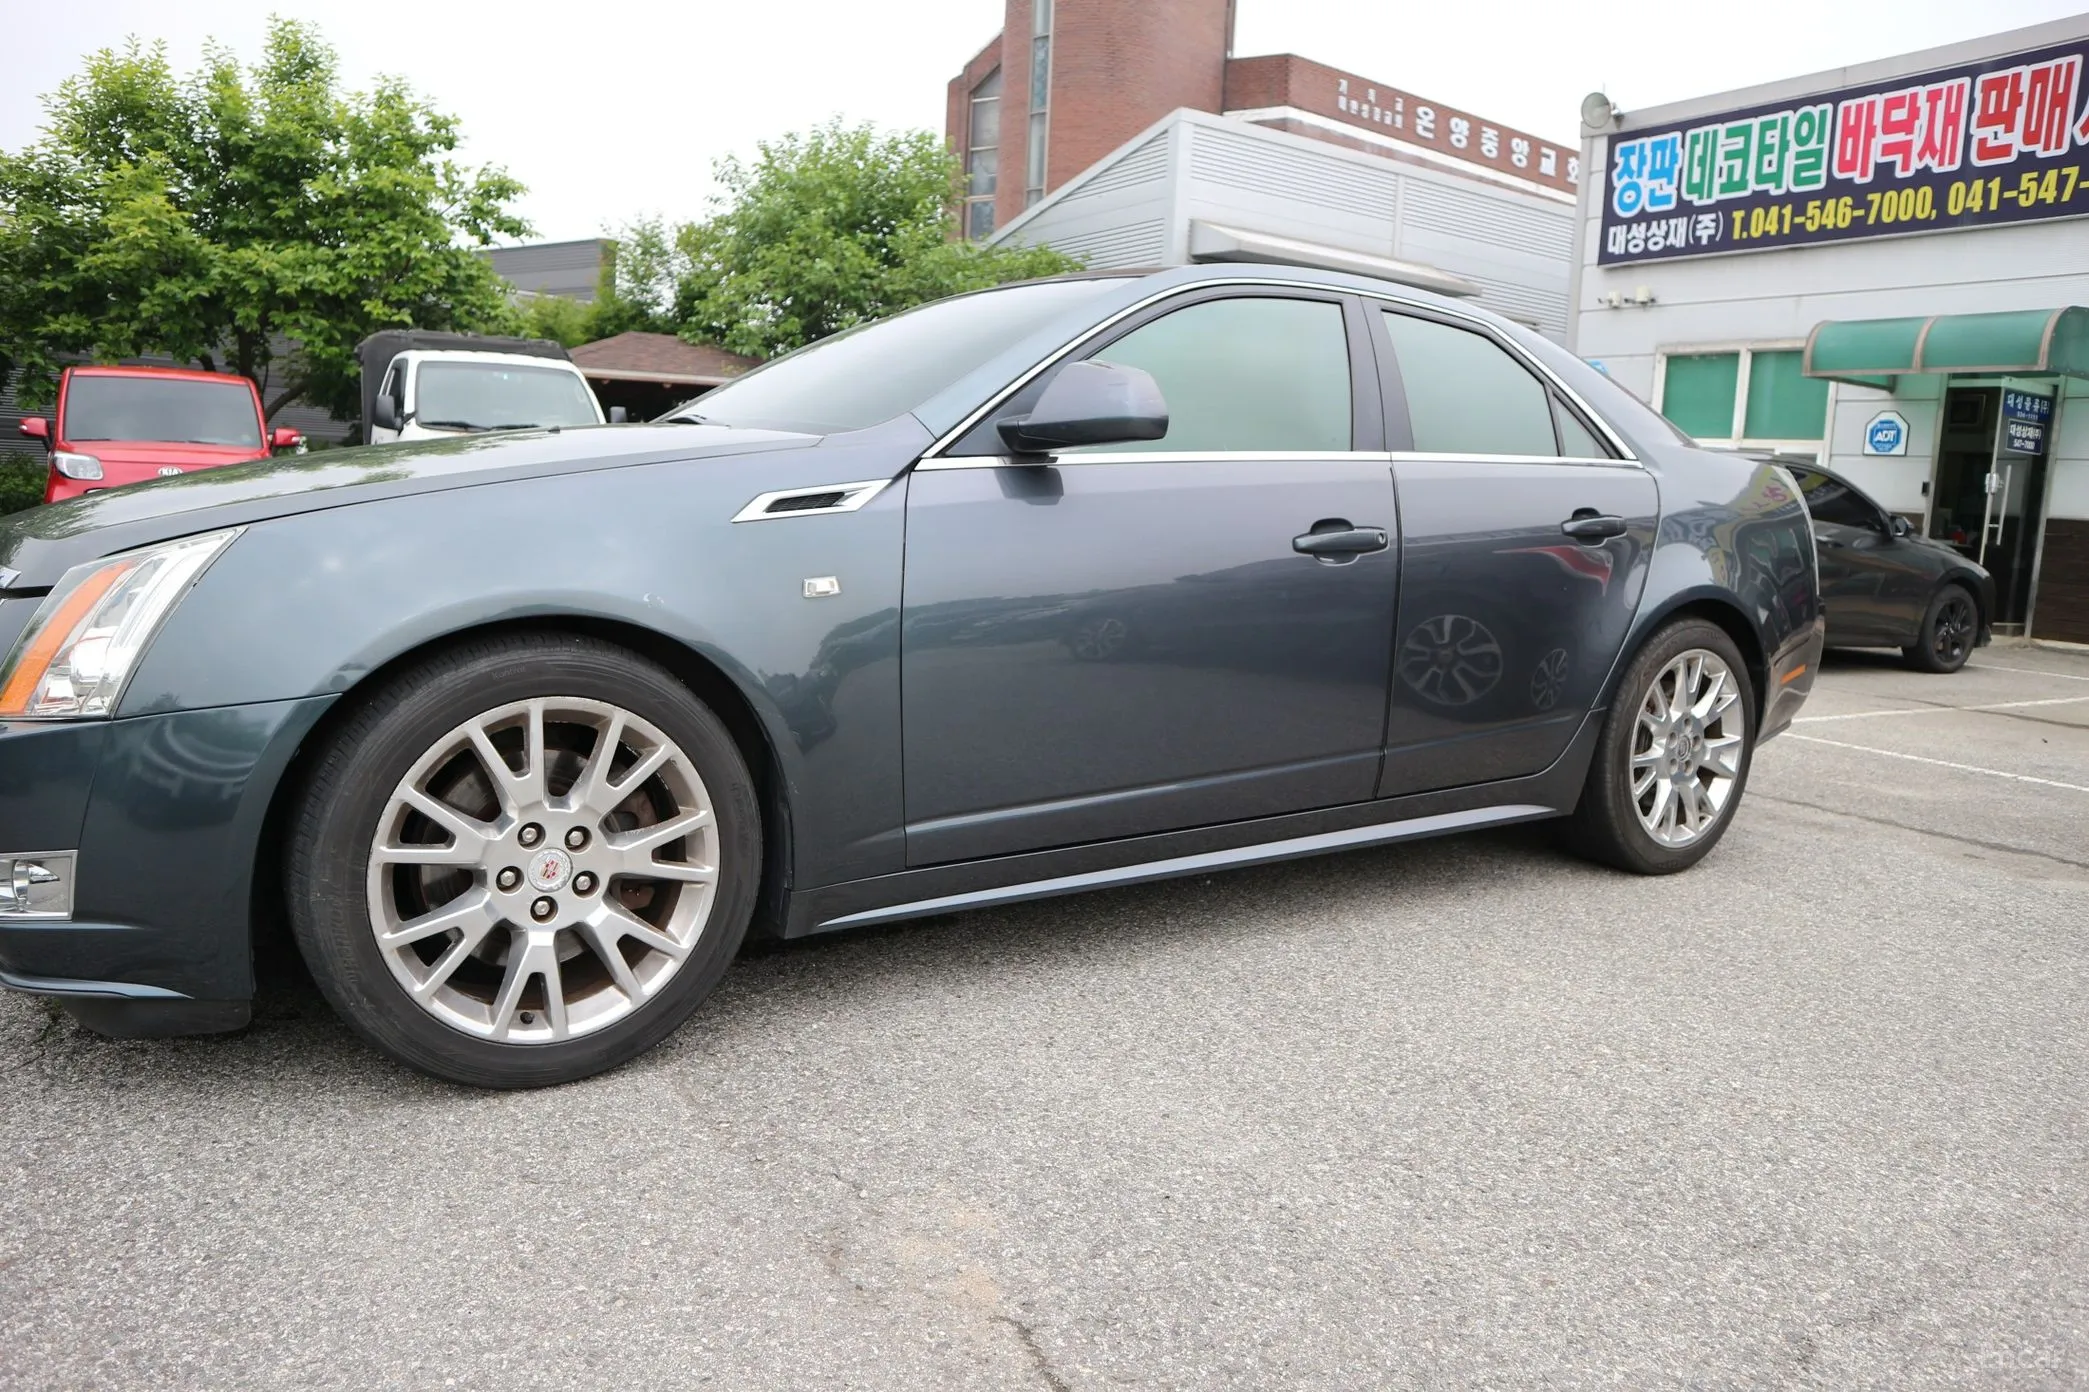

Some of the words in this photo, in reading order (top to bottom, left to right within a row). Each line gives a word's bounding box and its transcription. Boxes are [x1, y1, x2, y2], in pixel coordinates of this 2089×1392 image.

[1612, 132, 1683, 217] 장판
[1681, 104, 1832, 205] 데코타일
[1832, 77, 1971, 183] 바닥재
[1970, 54, 2082, 168] 판매
[1608, 211, 1723, 255] 대성상재(주)
[1873, 430, 1897, 442] ADT
